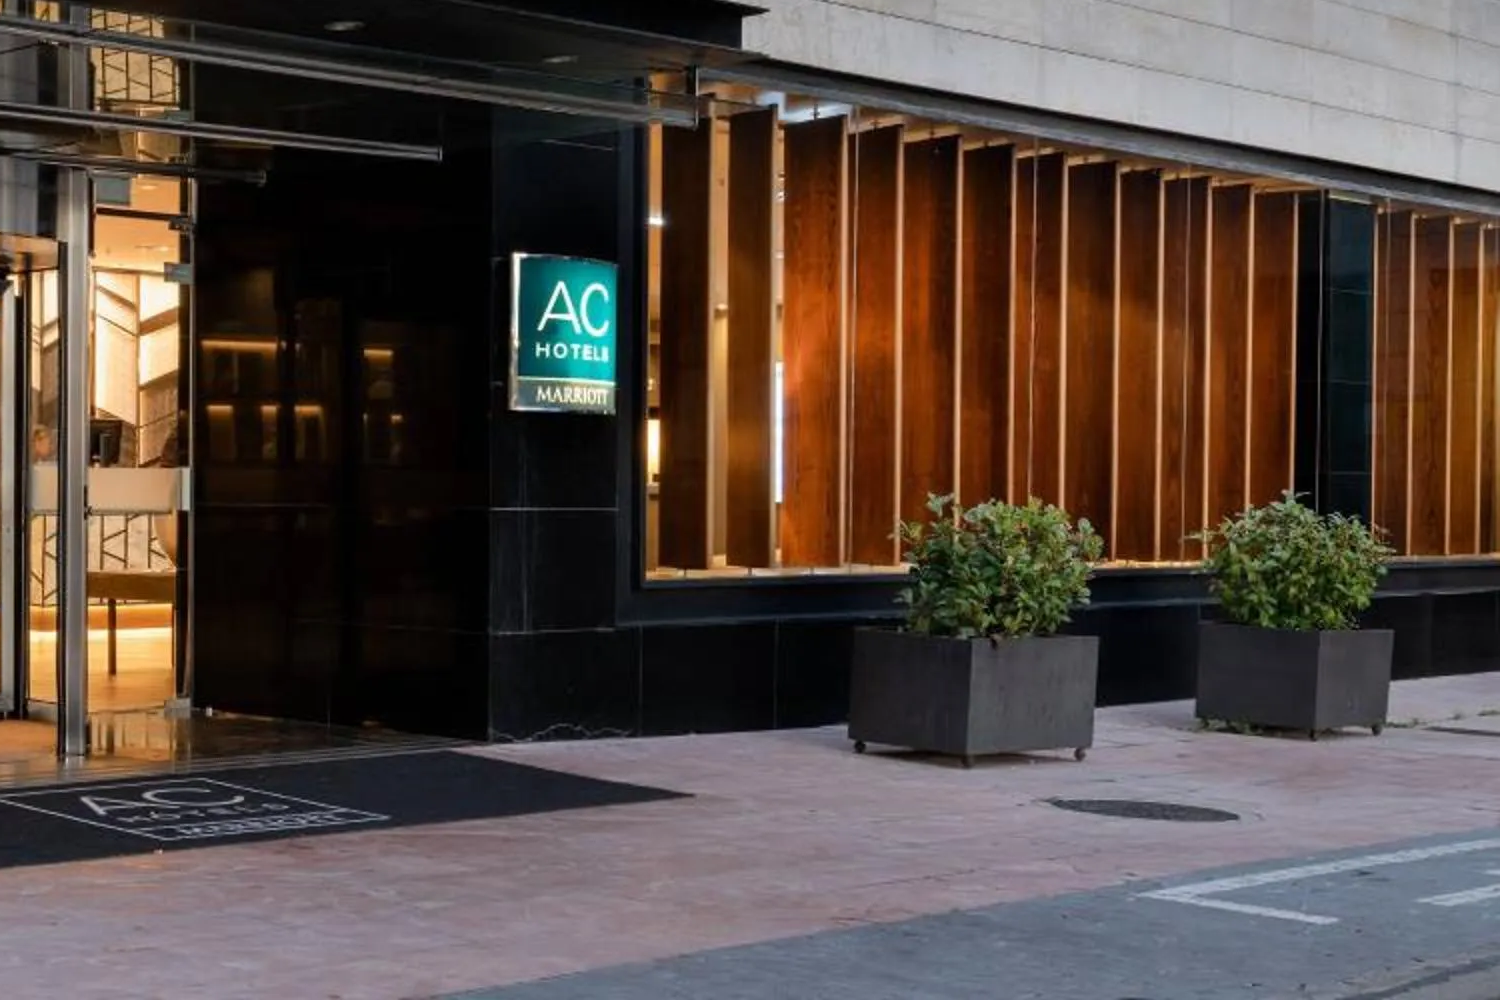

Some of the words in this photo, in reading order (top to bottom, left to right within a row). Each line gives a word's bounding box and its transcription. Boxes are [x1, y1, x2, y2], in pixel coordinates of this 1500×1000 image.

[536, 280, 610, 338] AC
[535, 385, 609, 406] MARRIOTT
[80, 786, 246, 816] AC
